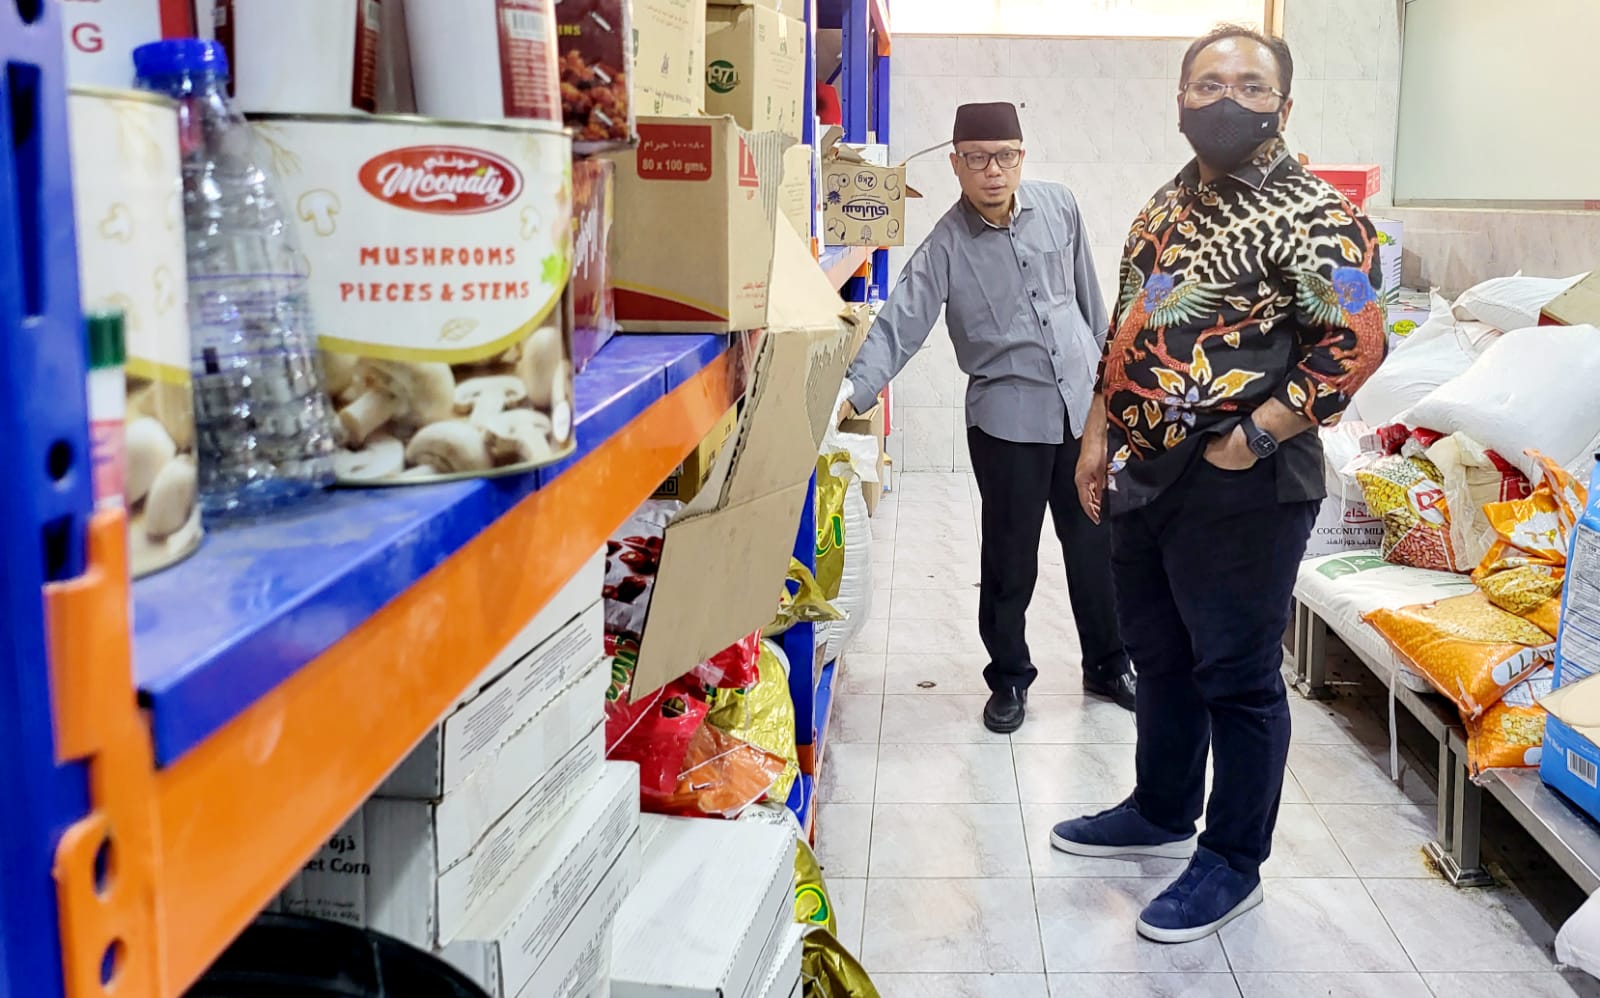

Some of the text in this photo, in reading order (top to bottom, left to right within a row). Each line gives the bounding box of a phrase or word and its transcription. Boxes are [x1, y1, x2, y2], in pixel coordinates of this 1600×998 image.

[706, 65, 738, 84] 1971
[641, 158, 655, 171] 80
[665, 159, 683, 172] 100
[684, 162, 707, 174] gms.
[376, 162, 505, 204] Moonaty
[857, 174, 874, 188] 2kg
[359, 246, 516, 267] MUSHROOMS
[440, 282, 455, 302] &
[461, 280, 529, 301] STEMS
[1316, 527, 1364, 537] COCONUT
[330, 858, 371, 876] Corn
